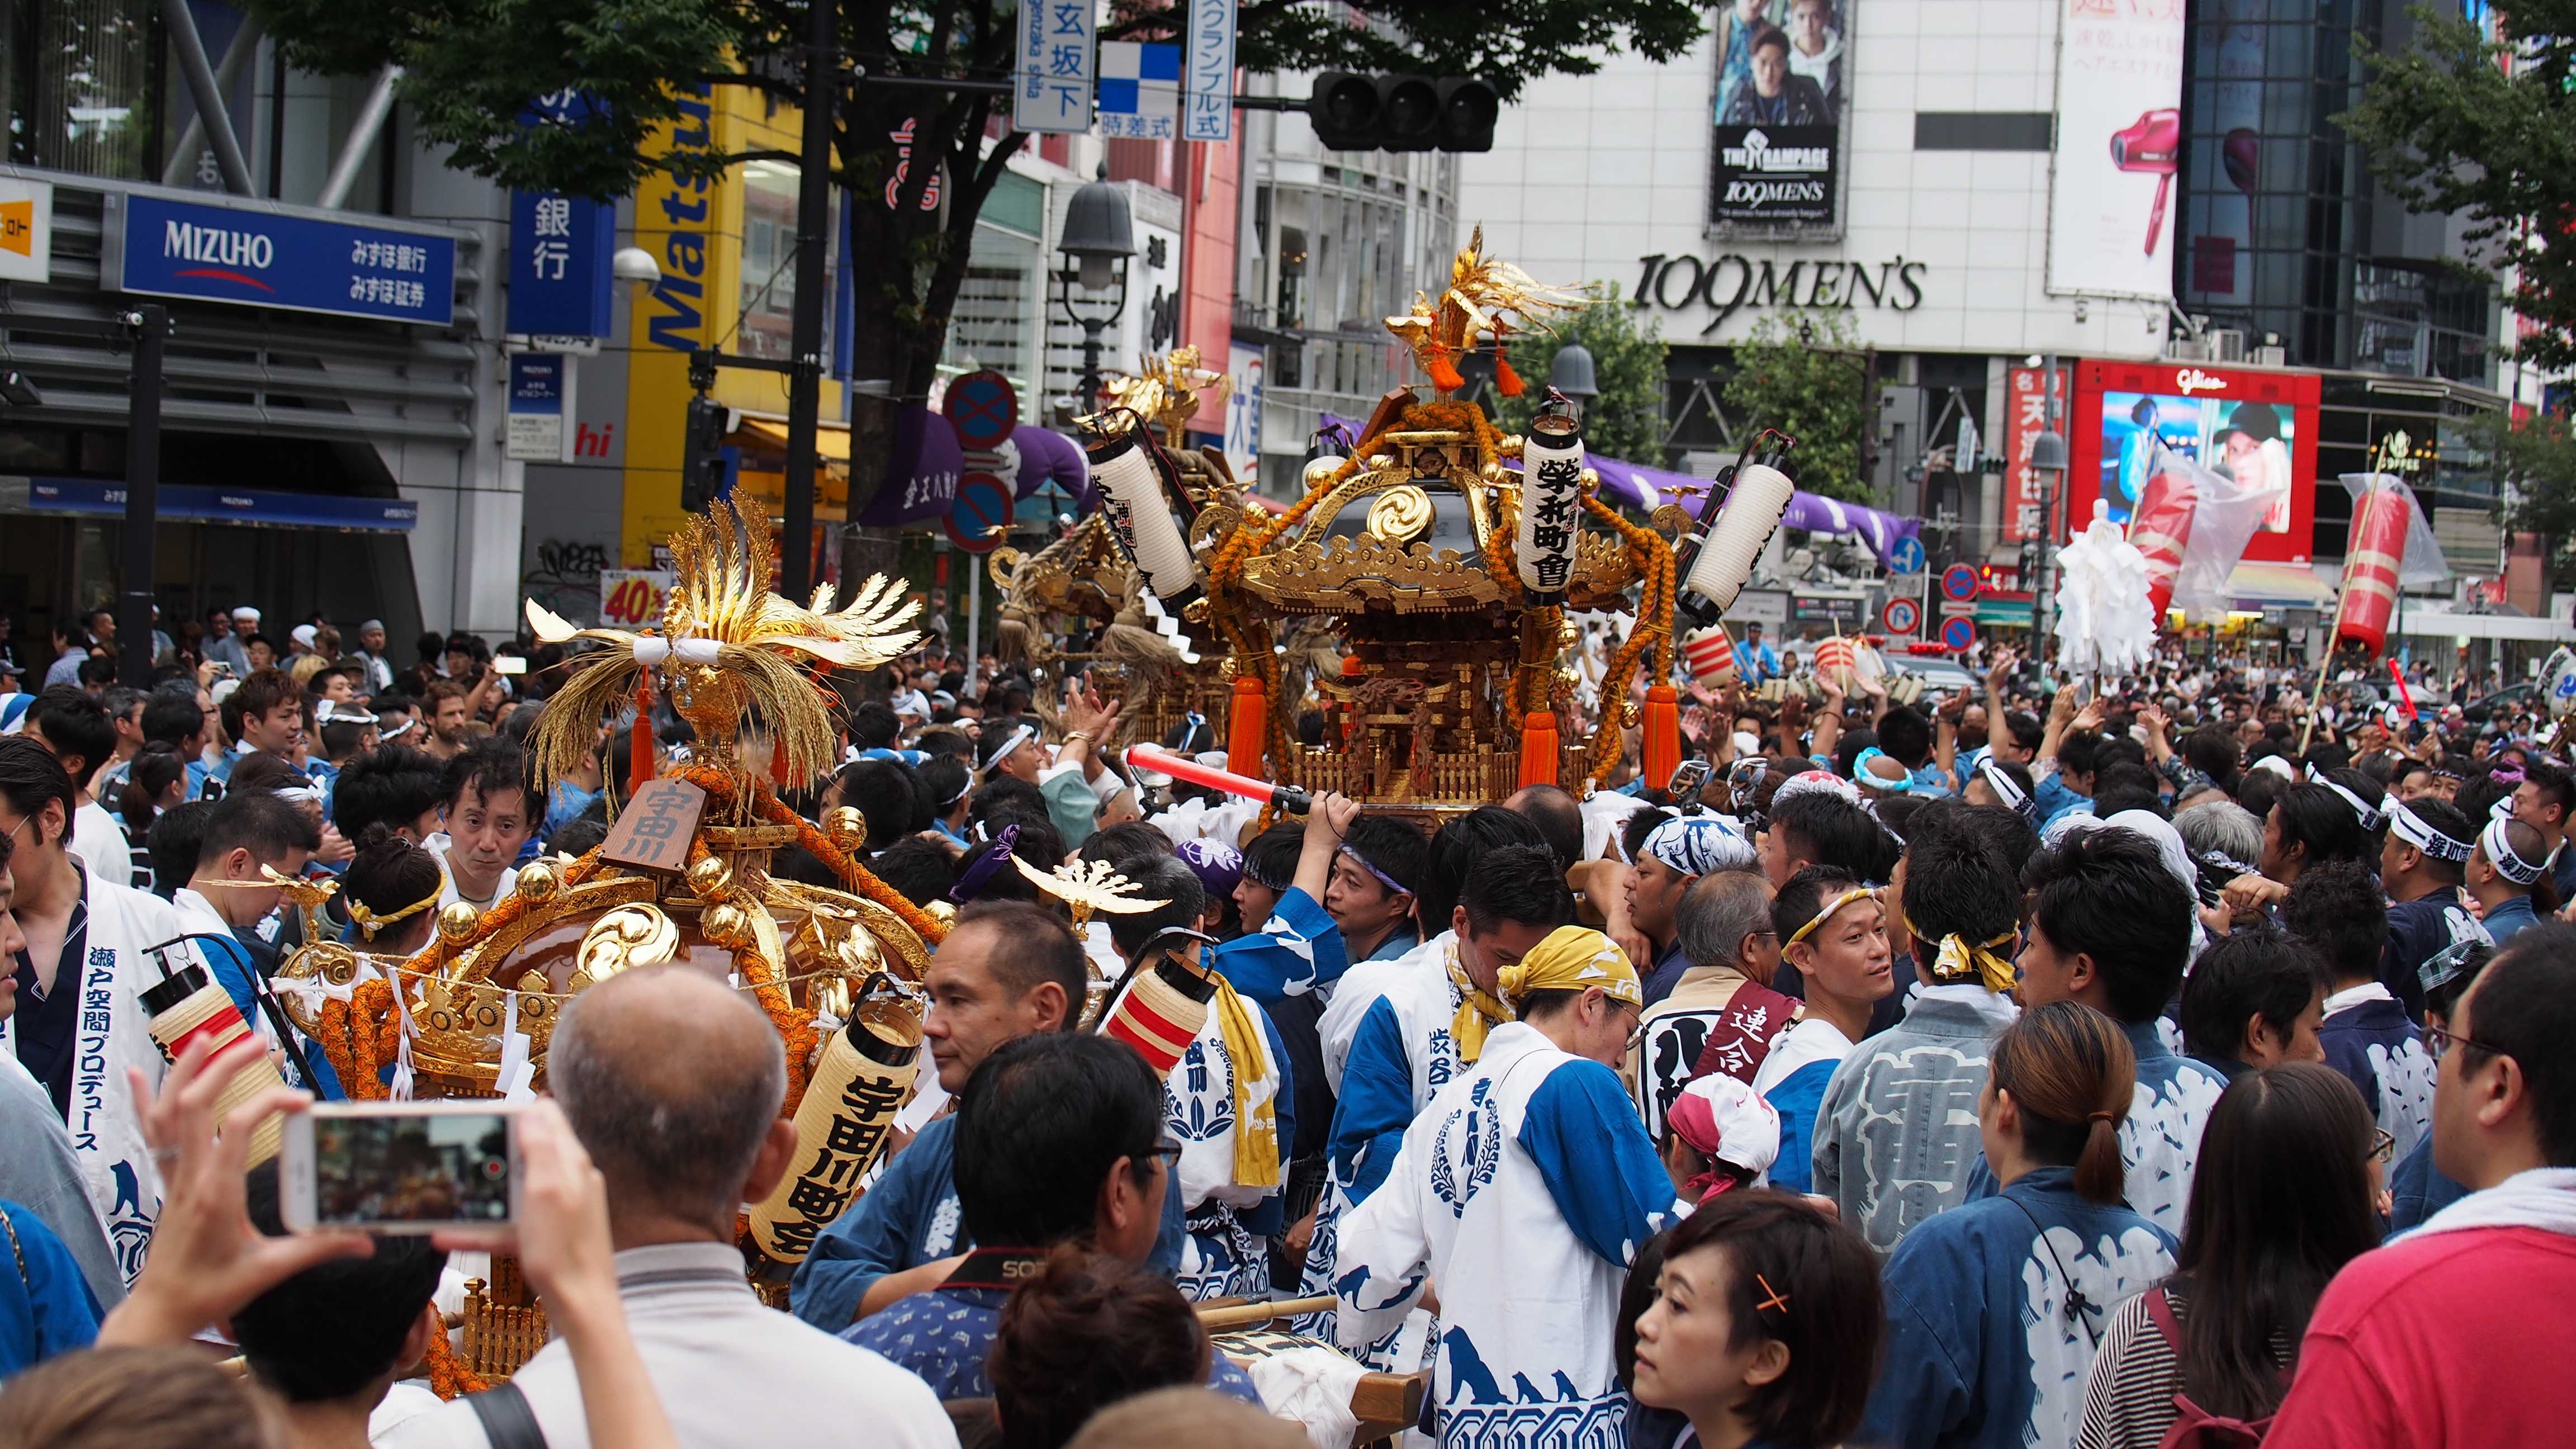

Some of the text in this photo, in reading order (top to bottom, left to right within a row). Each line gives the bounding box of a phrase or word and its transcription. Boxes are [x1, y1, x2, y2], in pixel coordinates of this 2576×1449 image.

[1102, 115, 1171, 138] 時差式
[1722, 148, 1829, 167] THE RAMPAGE
[1723, 180, 1825, 209] 109MEN'S
[164, 220, 273, 269] MIZUHO
[352, 239, 427, 273] みずほ銀行
[350, 274, 425, 307] みずほ証券
[1633, 254, 1926, 335] 109MEN'S
[620, 784, 693, 862] 宇田川
[75, 946, 116, 1152] 瀬戸空間プロデュース
[1715, 1004, 1764, 1073] 連合
[769, 1074, 906, 1255] 宇田川町会
